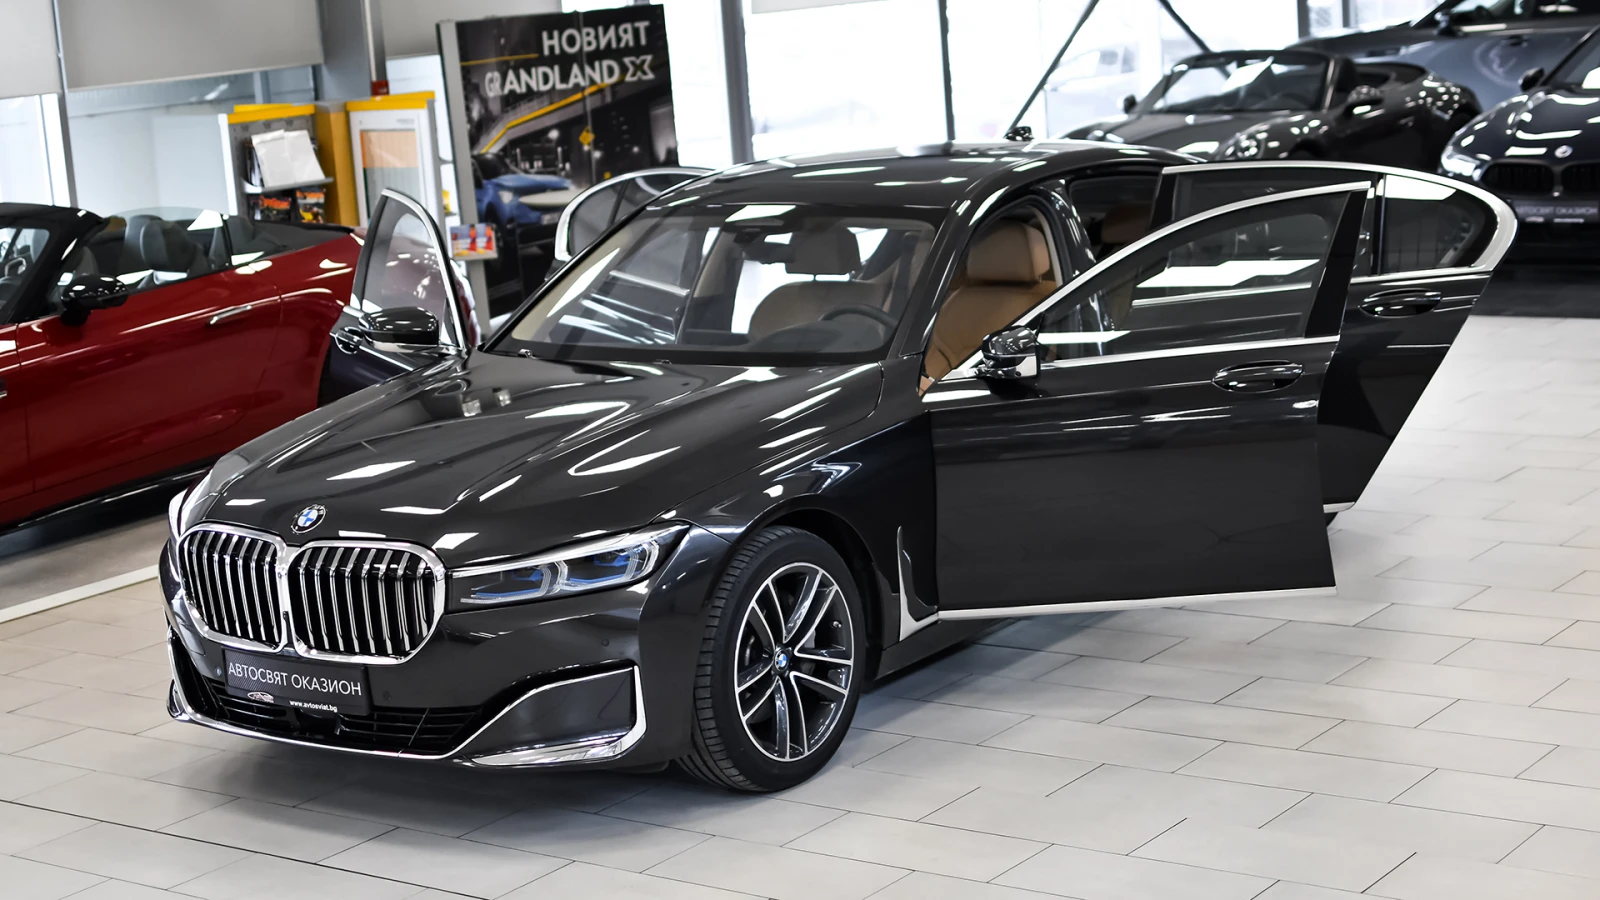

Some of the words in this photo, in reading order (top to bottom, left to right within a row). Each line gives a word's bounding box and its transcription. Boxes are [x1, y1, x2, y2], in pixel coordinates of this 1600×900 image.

[541, 20, 650, 57] НОВИЯТ
[484, 59, 621, 98] GRANDLAND
[228, 662, 288, 687] АВТОСВЯТ
[290, 673, 362, 697] ОКАЗИОН
[289, 700, 338, 713] www.avtosviat.bg
